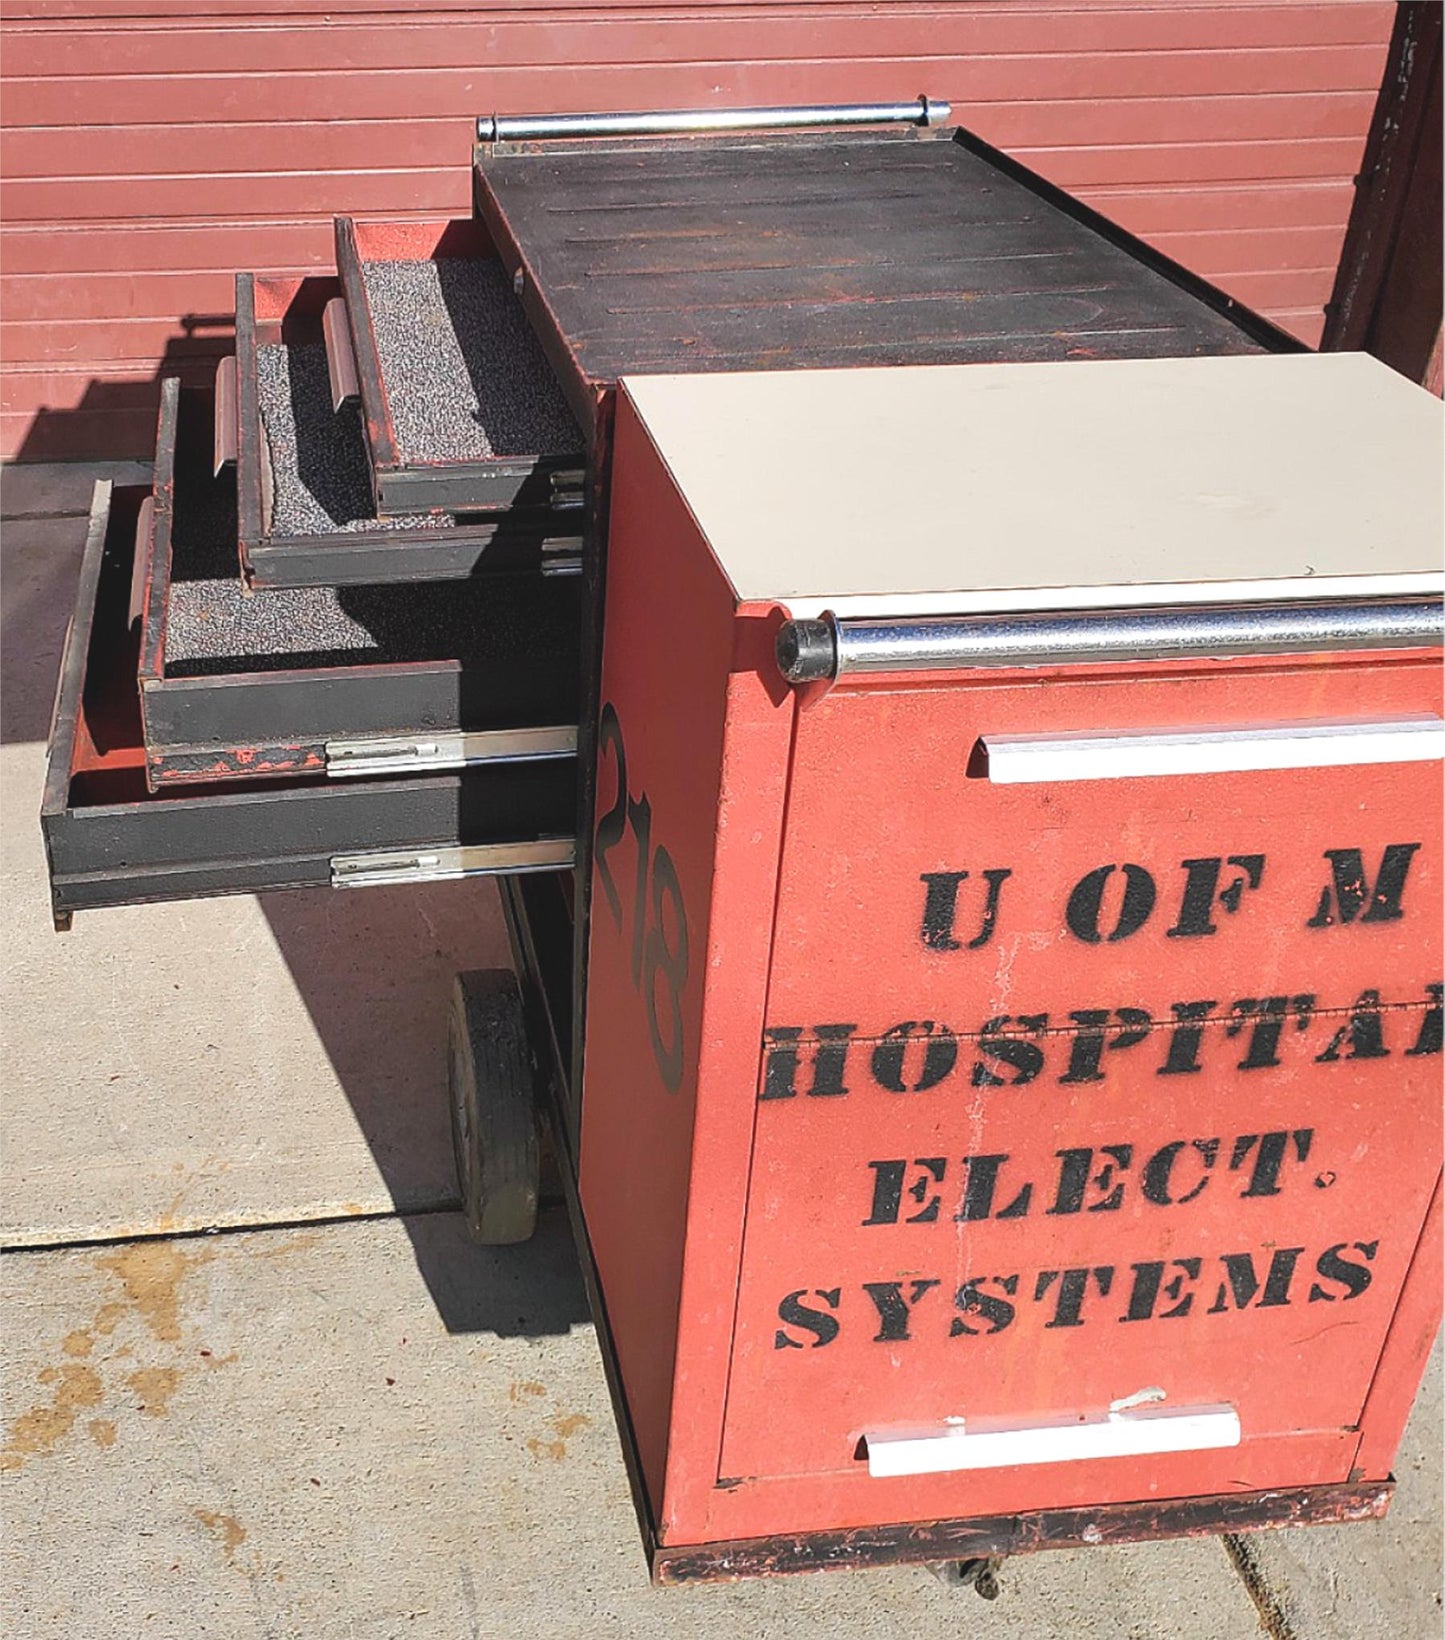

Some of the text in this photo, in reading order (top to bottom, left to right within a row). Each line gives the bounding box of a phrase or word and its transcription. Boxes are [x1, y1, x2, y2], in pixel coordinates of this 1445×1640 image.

[595, 702, 689, 1095] 218
[920, 842, 1422, 950] U OF M
[861, 1129, 1338, 1226] ELECT.
[774, 1240, 1381, 1350] SYSTEMS
